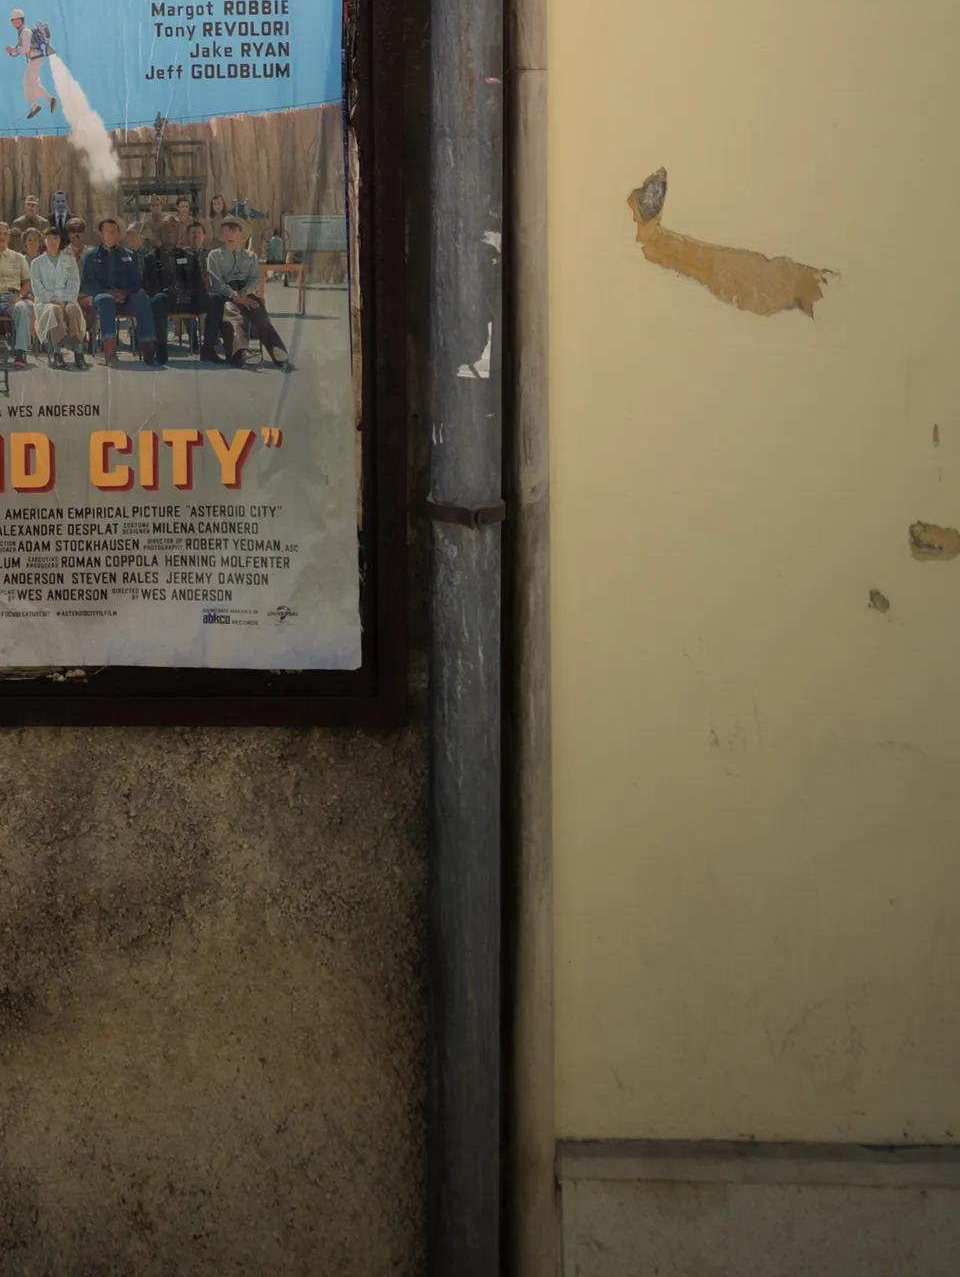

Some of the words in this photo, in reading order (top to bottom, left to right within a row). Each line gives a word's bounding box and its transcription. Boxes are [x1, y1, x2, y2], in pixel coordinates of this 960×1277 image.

[151, 1, 214, 20] Margot
[224, 0, 289, 15] ROBBIE
[154, 22, 196, 41] Tony
[202, 21, 290, 37] REVOLORI
[190, 41, 233, 58] Jake
[241, 41, 290, 57] RYAN
[145, 64, 183, 80] Jeff
[191, 63, 290, 79] GOLDBLUM
[7, 405, 33, 418] WES
[38, 404, 100, 417] ANDERSON
[5, 508, 63, 520] AMERICAN
[68, 507, 129, 520] EMPIRICAL
[132, 505, 181, 518] PICTURE
[68, 524, 119, 535] DESPLAT
[153, 522, 195, 534] MILENA
[198, 522, 258, 534] CANONERO
[18, 541, 51, 552] ADAM
[55, 539, 140, 552] STOCKHAUSEN
[185, 538, 229, 550] ROBERT
[61, 556, 101, 568] ROMAN
[105, 555, 159, 567] COPPOLA
[165, 555, 216, 567] HENNING
[220, 556, 290, 569] MOLFENTER
[3, 573, 64, 585] ANDERSON
[72, 572, 117, 584] STEVEN
[122, 572, 159, 584] RALES
[166, 572, 213, 584] JEREMY
[218, 573, 269, 585] DAWSON
[17, 589, 42, 601] WES
[47, 589, 108, 601] ANDERSON
[141, 588, 166, 600] WES
[171, 589, 232, 602] ANDERSON
